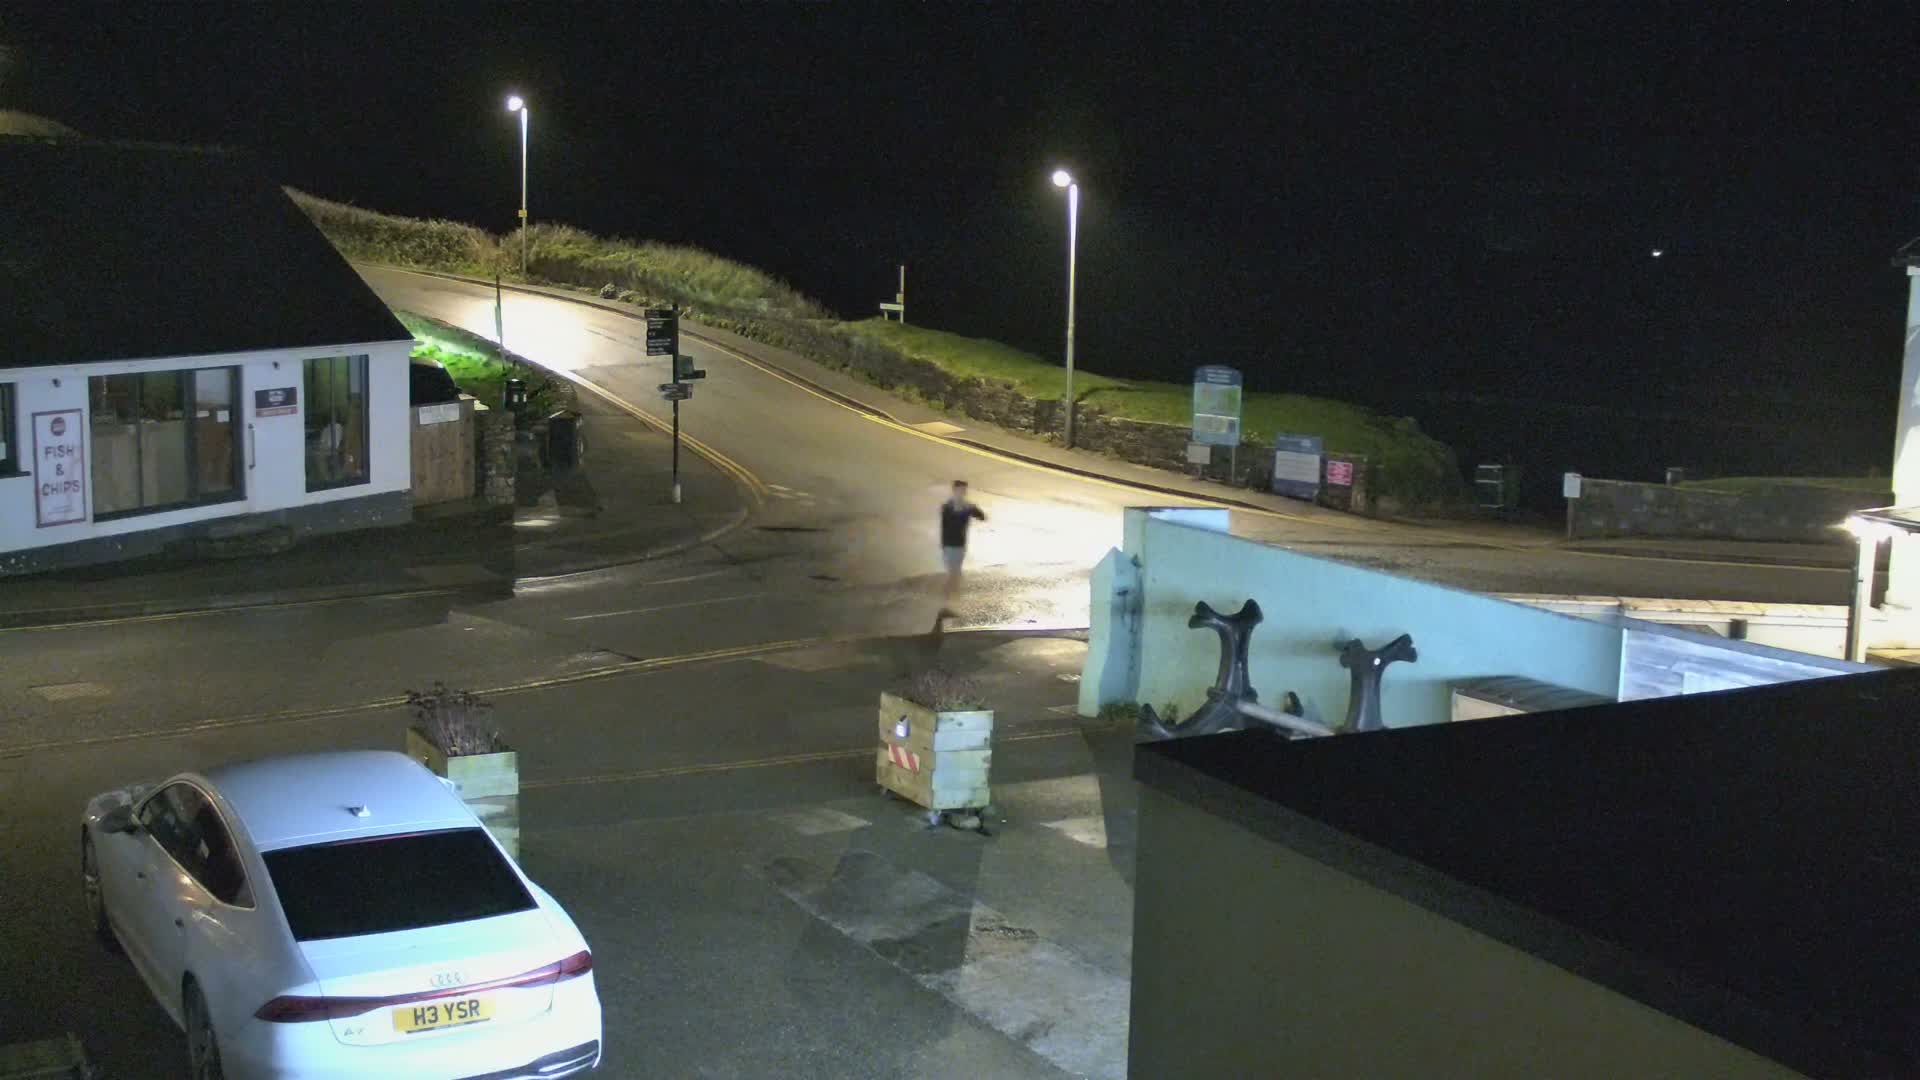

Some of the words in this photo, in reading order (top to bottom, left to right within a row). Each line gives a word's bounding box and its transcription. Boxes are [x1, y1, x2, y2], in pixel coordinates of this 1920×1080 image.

[45, 445, 74, 459] FISH
[56, 464, 65, 476] &
[42, 480, 80, 496] CHIPS
[413, 1006, 438, 1025] H3
[444, 1000, 480, 1020] YSR
